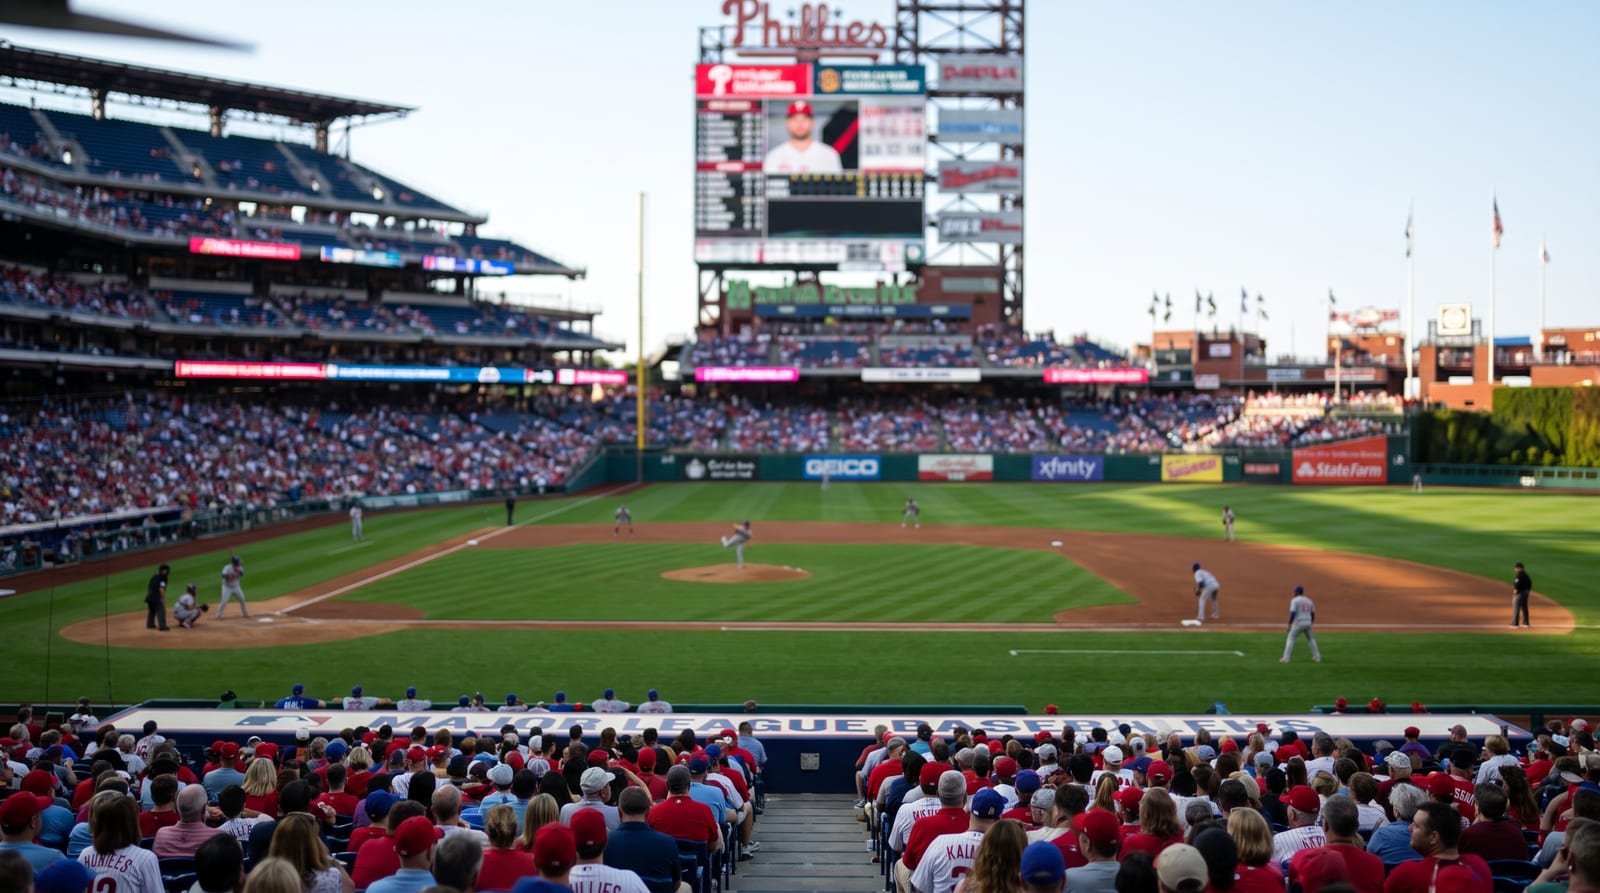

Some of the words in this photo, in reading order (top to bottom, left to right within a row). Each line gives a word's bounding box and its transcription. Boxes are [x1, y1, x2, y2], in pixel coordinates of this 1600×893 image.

[722, 0, 887, 48] Phillies
[806, 459, 878, 476] GEICO
[1040, 457, 1096, 479] xfinity
[369, 715, 602, 730] MAJOR
[622, 717, 868, 732] LEAGUE
